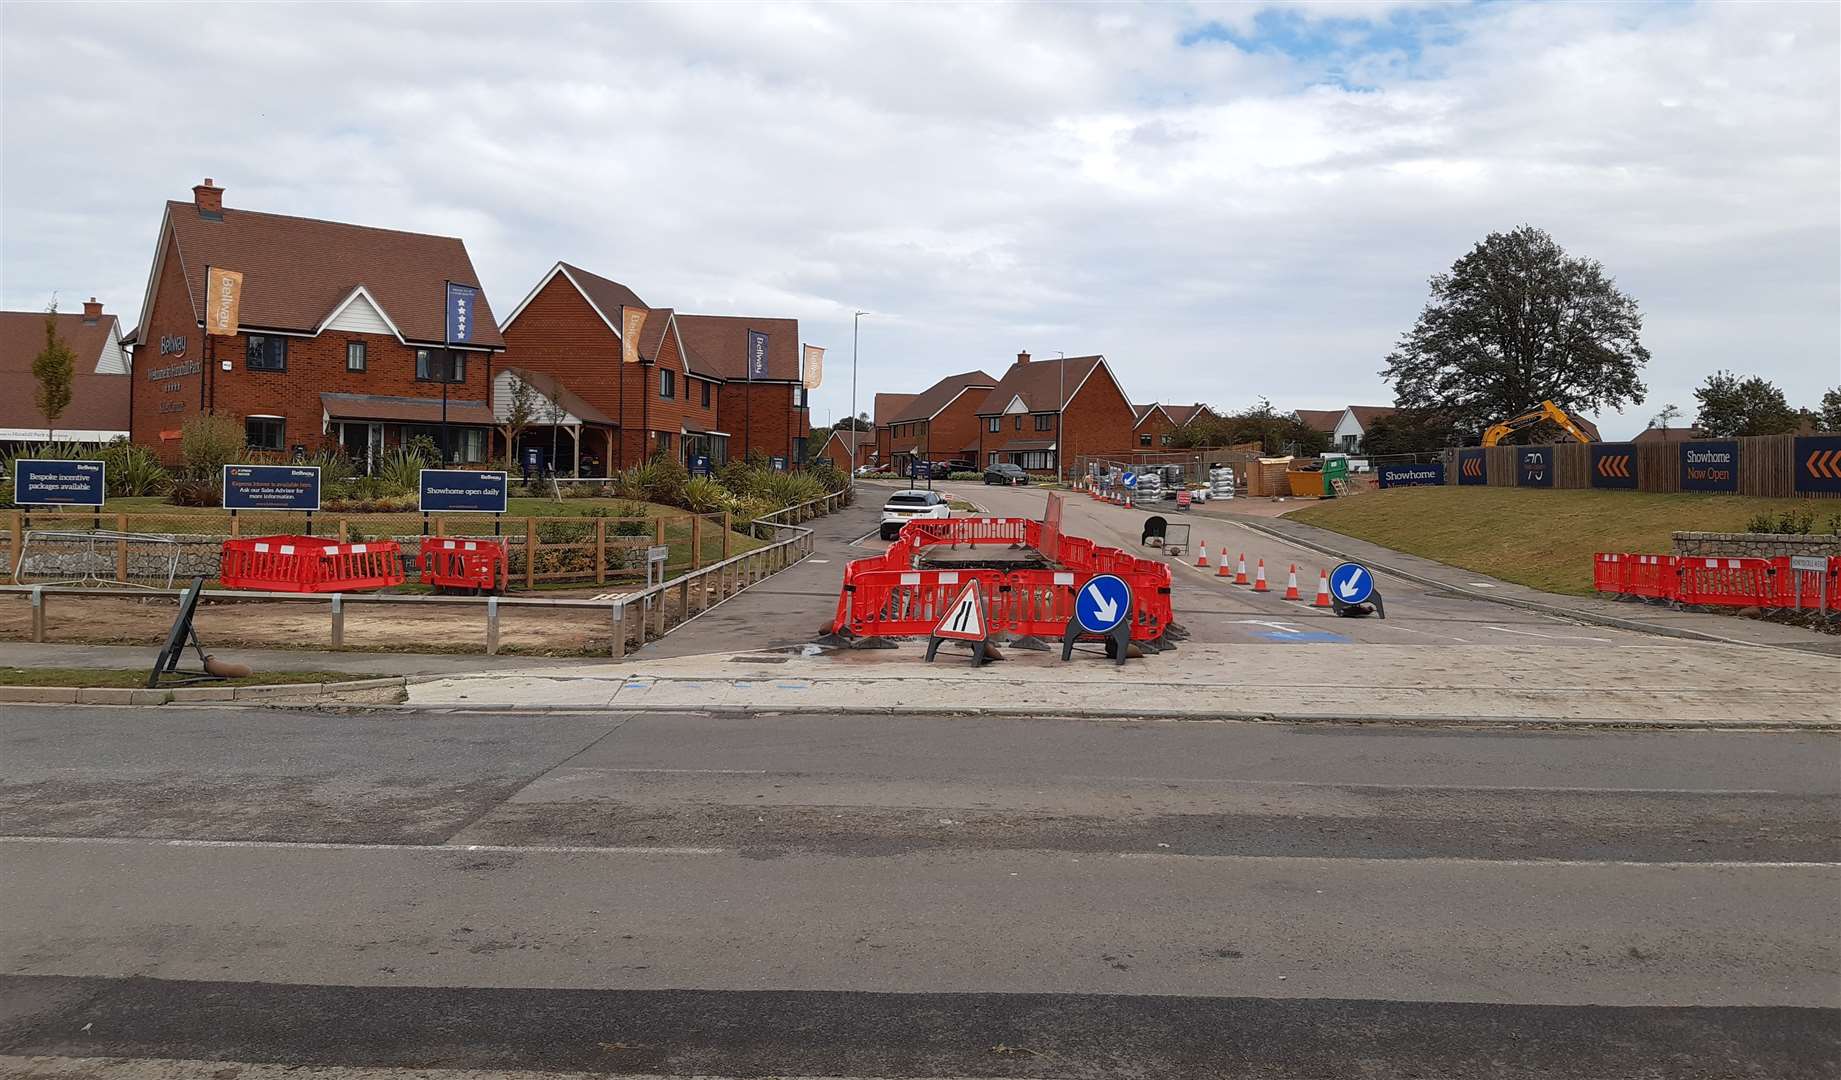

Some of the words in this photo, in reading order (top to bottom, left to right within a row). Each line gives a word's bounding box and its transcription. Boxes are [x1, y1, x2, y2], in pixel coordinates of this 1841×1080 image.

[217, 277, 233, 329] Bellway
[160, 335, 187, 357] Bellway
[754, 336, 764, 374] Bellway
[1687, 450, 1730, 463] Showhome
[77, 464, 99, 472] Bellway
[29, 473, 58, 482] Bespoke
[1385, 470, 1436, 481] Showhome
[1688, 467, 1706, 480] Now
[1707, 467, 1729, 482] Open
[28, 483, 59, 491] packages
[427, 487, 464, 495] Showhome
[465, 488, 482, 496] open
[483, 488, 500, 496] daily
